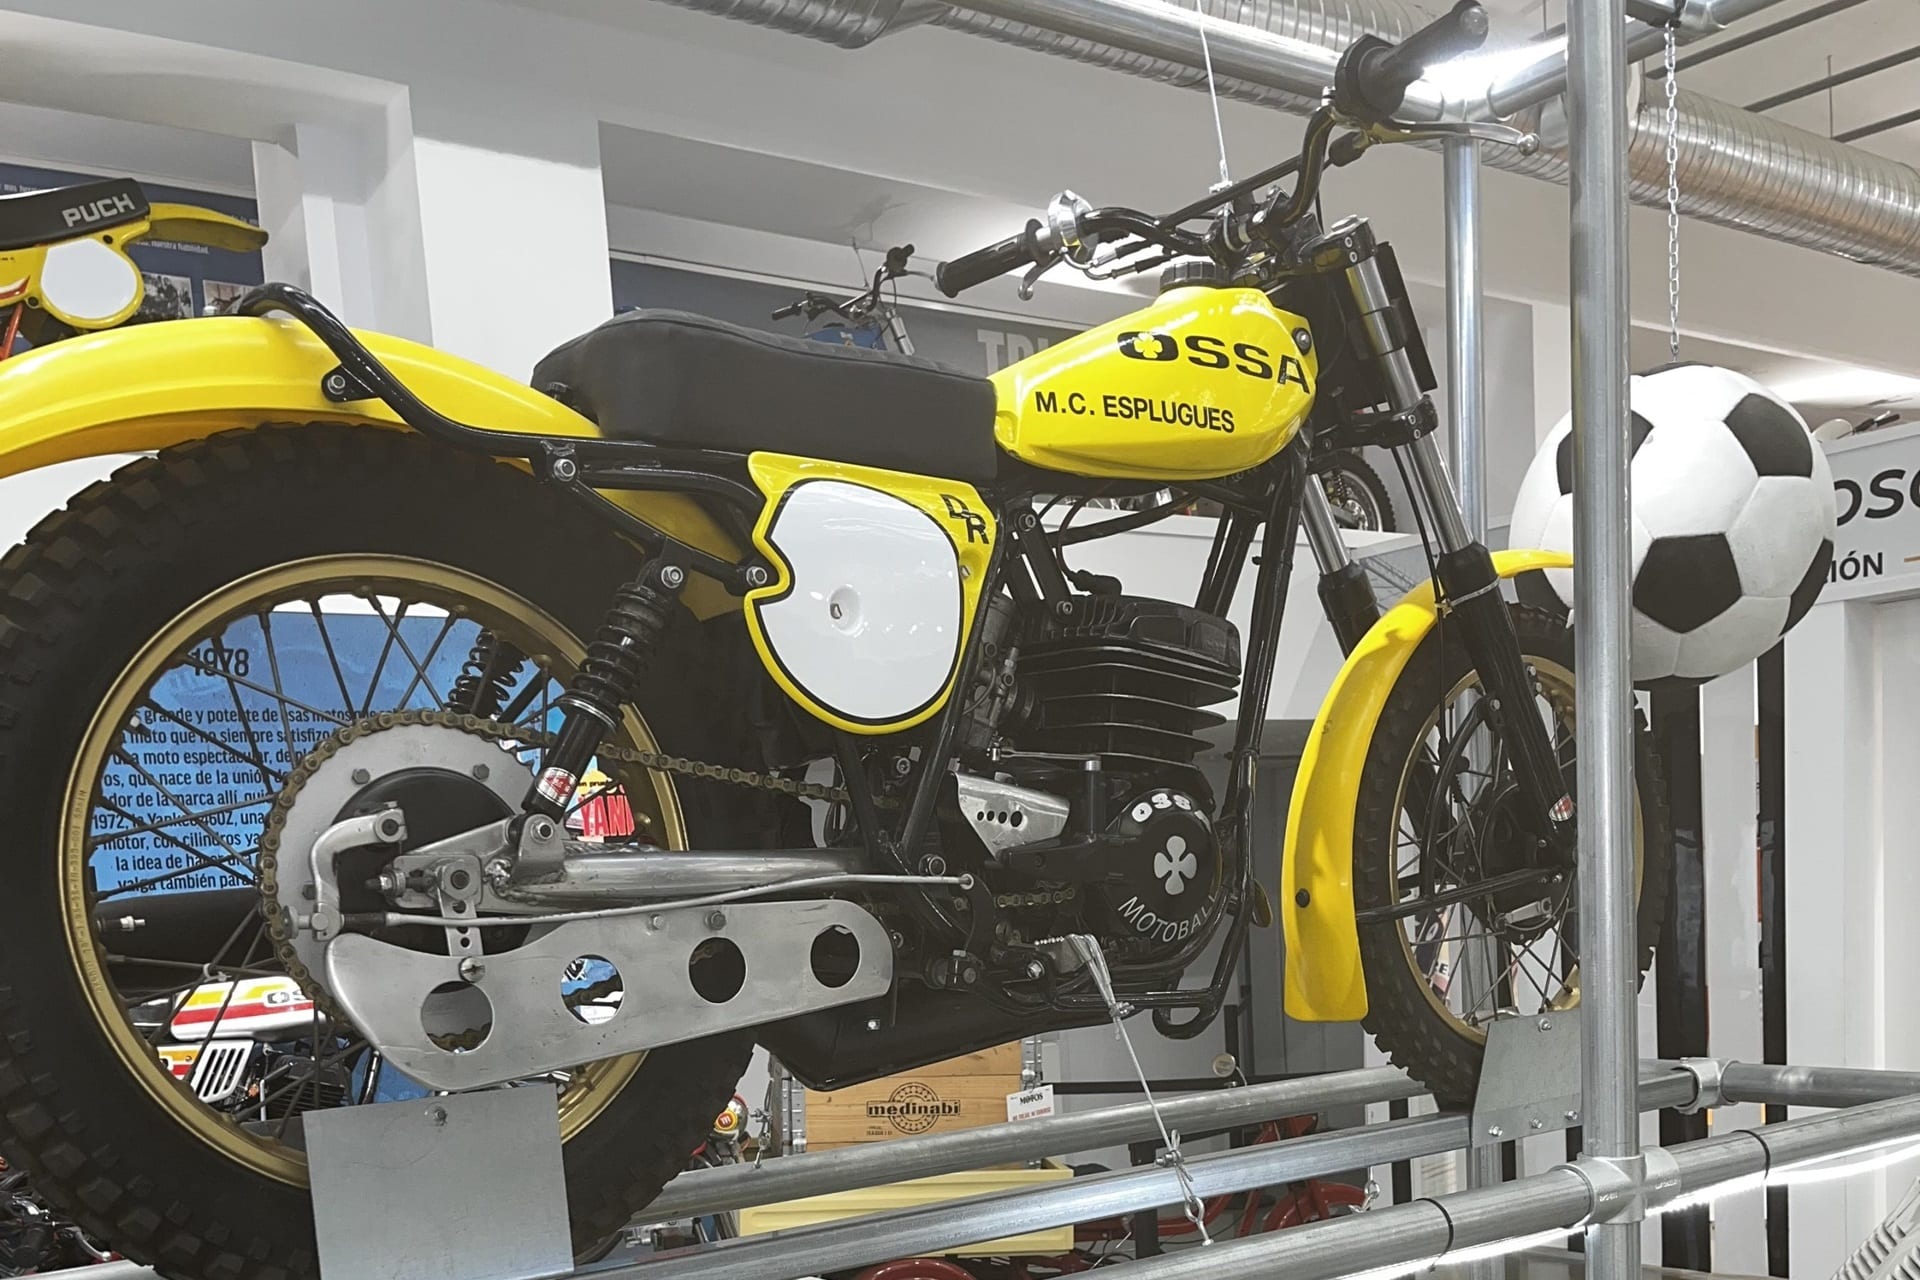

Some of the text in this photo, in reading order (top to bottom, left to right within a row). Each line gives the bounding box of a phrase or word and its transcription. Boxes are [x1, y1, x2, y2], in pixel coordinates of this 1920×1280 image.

[62, 193, 135, 227] PUCH
[1117, 331, 1310, 394] OSSA
[1035, 391, 1235, 434] M.C. ESPLUGUES
[1833, 468, 1920, 527] OS
[1826, 550, 1883, 583] IÓN
[190, 647, 250, 677] 1978
[195, 710, 204, 723] y
[207, 708, 259, 724] potete
[262, 708, 279, 722] de
[282, 709, 311, 722] sas
[130, 729, 166, 744] moto
[170, 730, 196, 745] que
[113, 752, 140, 765] ua
[143, 750, 180, 764] moto
[183, 748, 273, 766] espectacur,
[158, 772, 192, 785] nace
[195, 770, 212, 785] de
[216, 769, 229, 784] la
[232, 767, 268, 784] unió
[105, 792, 133, 807] dor
[136, 792, 154, 807] de
[156, 790, 169, 806] la
[94, 813, 129, 829] 1972,
[103, 836, 149, 851] motor,
[182, 831, 242, 848] cilindros
[115, 855, 129, 872] la
[132, 855, 162, 871] idea
[165, 853, 182, 869] de
[186, 853, 224, 868] haer
[160, 873, 216, 891] también
[868, 1101, 959, 1115] medinabi
